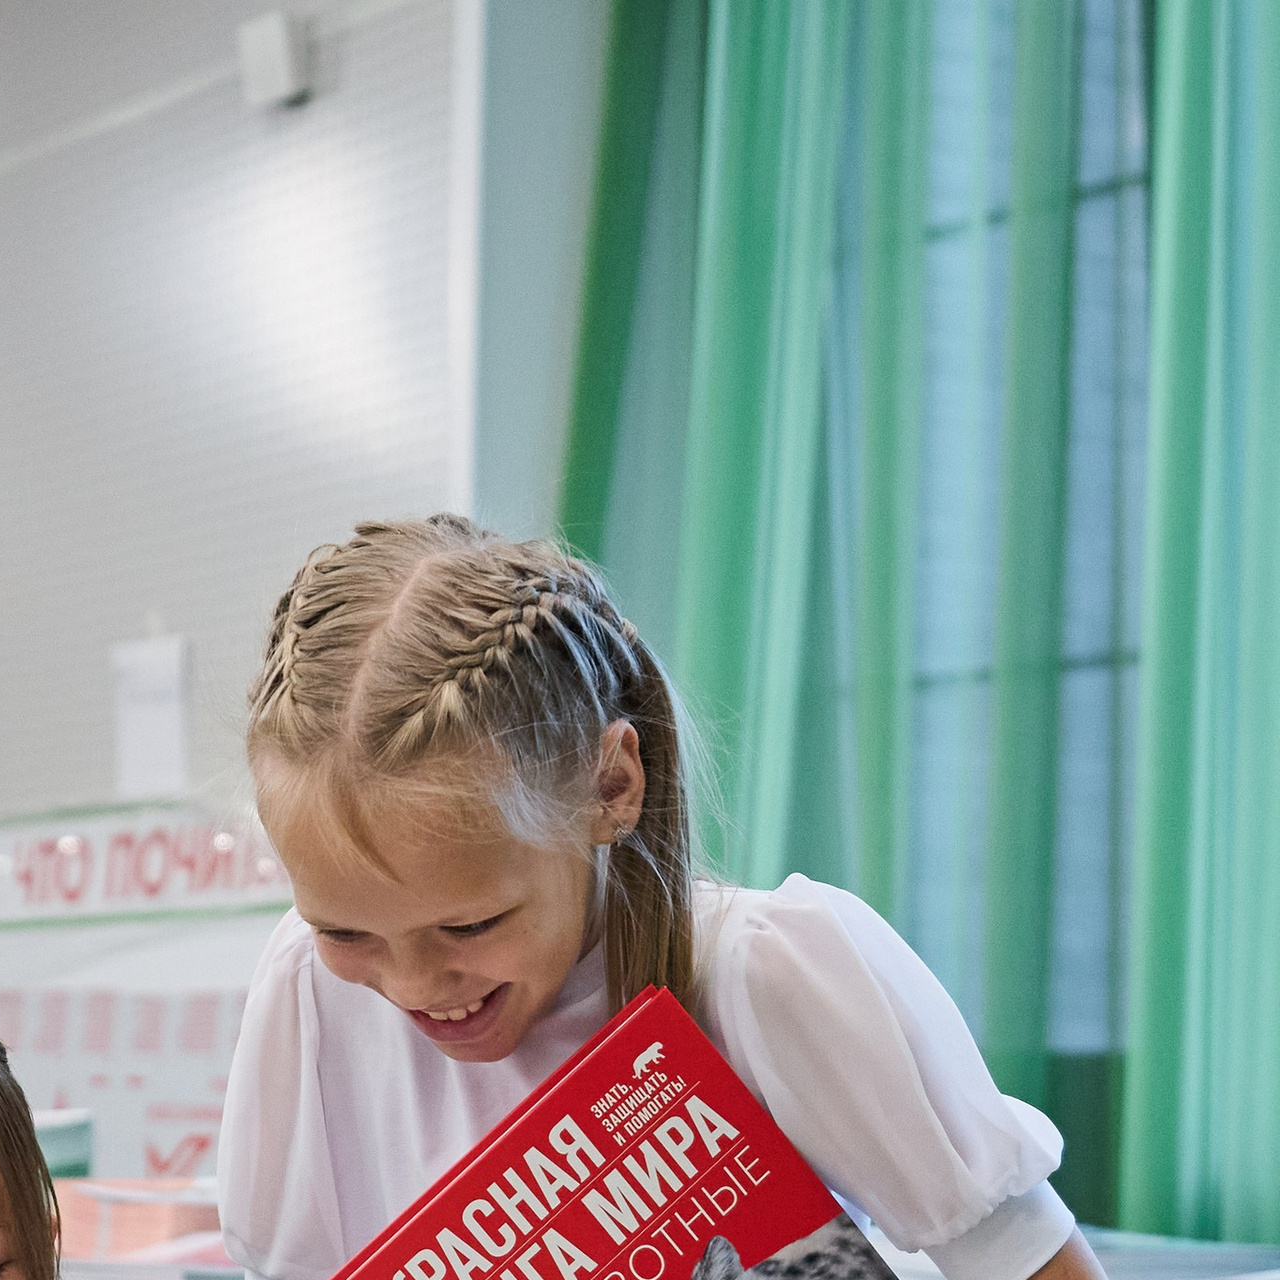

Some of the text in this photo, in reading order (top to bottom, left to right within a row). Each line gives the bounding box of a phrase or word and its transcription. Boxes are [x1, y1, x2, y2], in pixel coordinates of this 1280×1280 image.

[590, 1082, 634, 1119] ЗНАТЬ,
[601, 1071, 668, 1133] ЗАЩИЩАТЬ
[612, 1074, 687, 1147] И ПОМОГАТЬ!
[580, 1094, 741, 1246] МИРА
